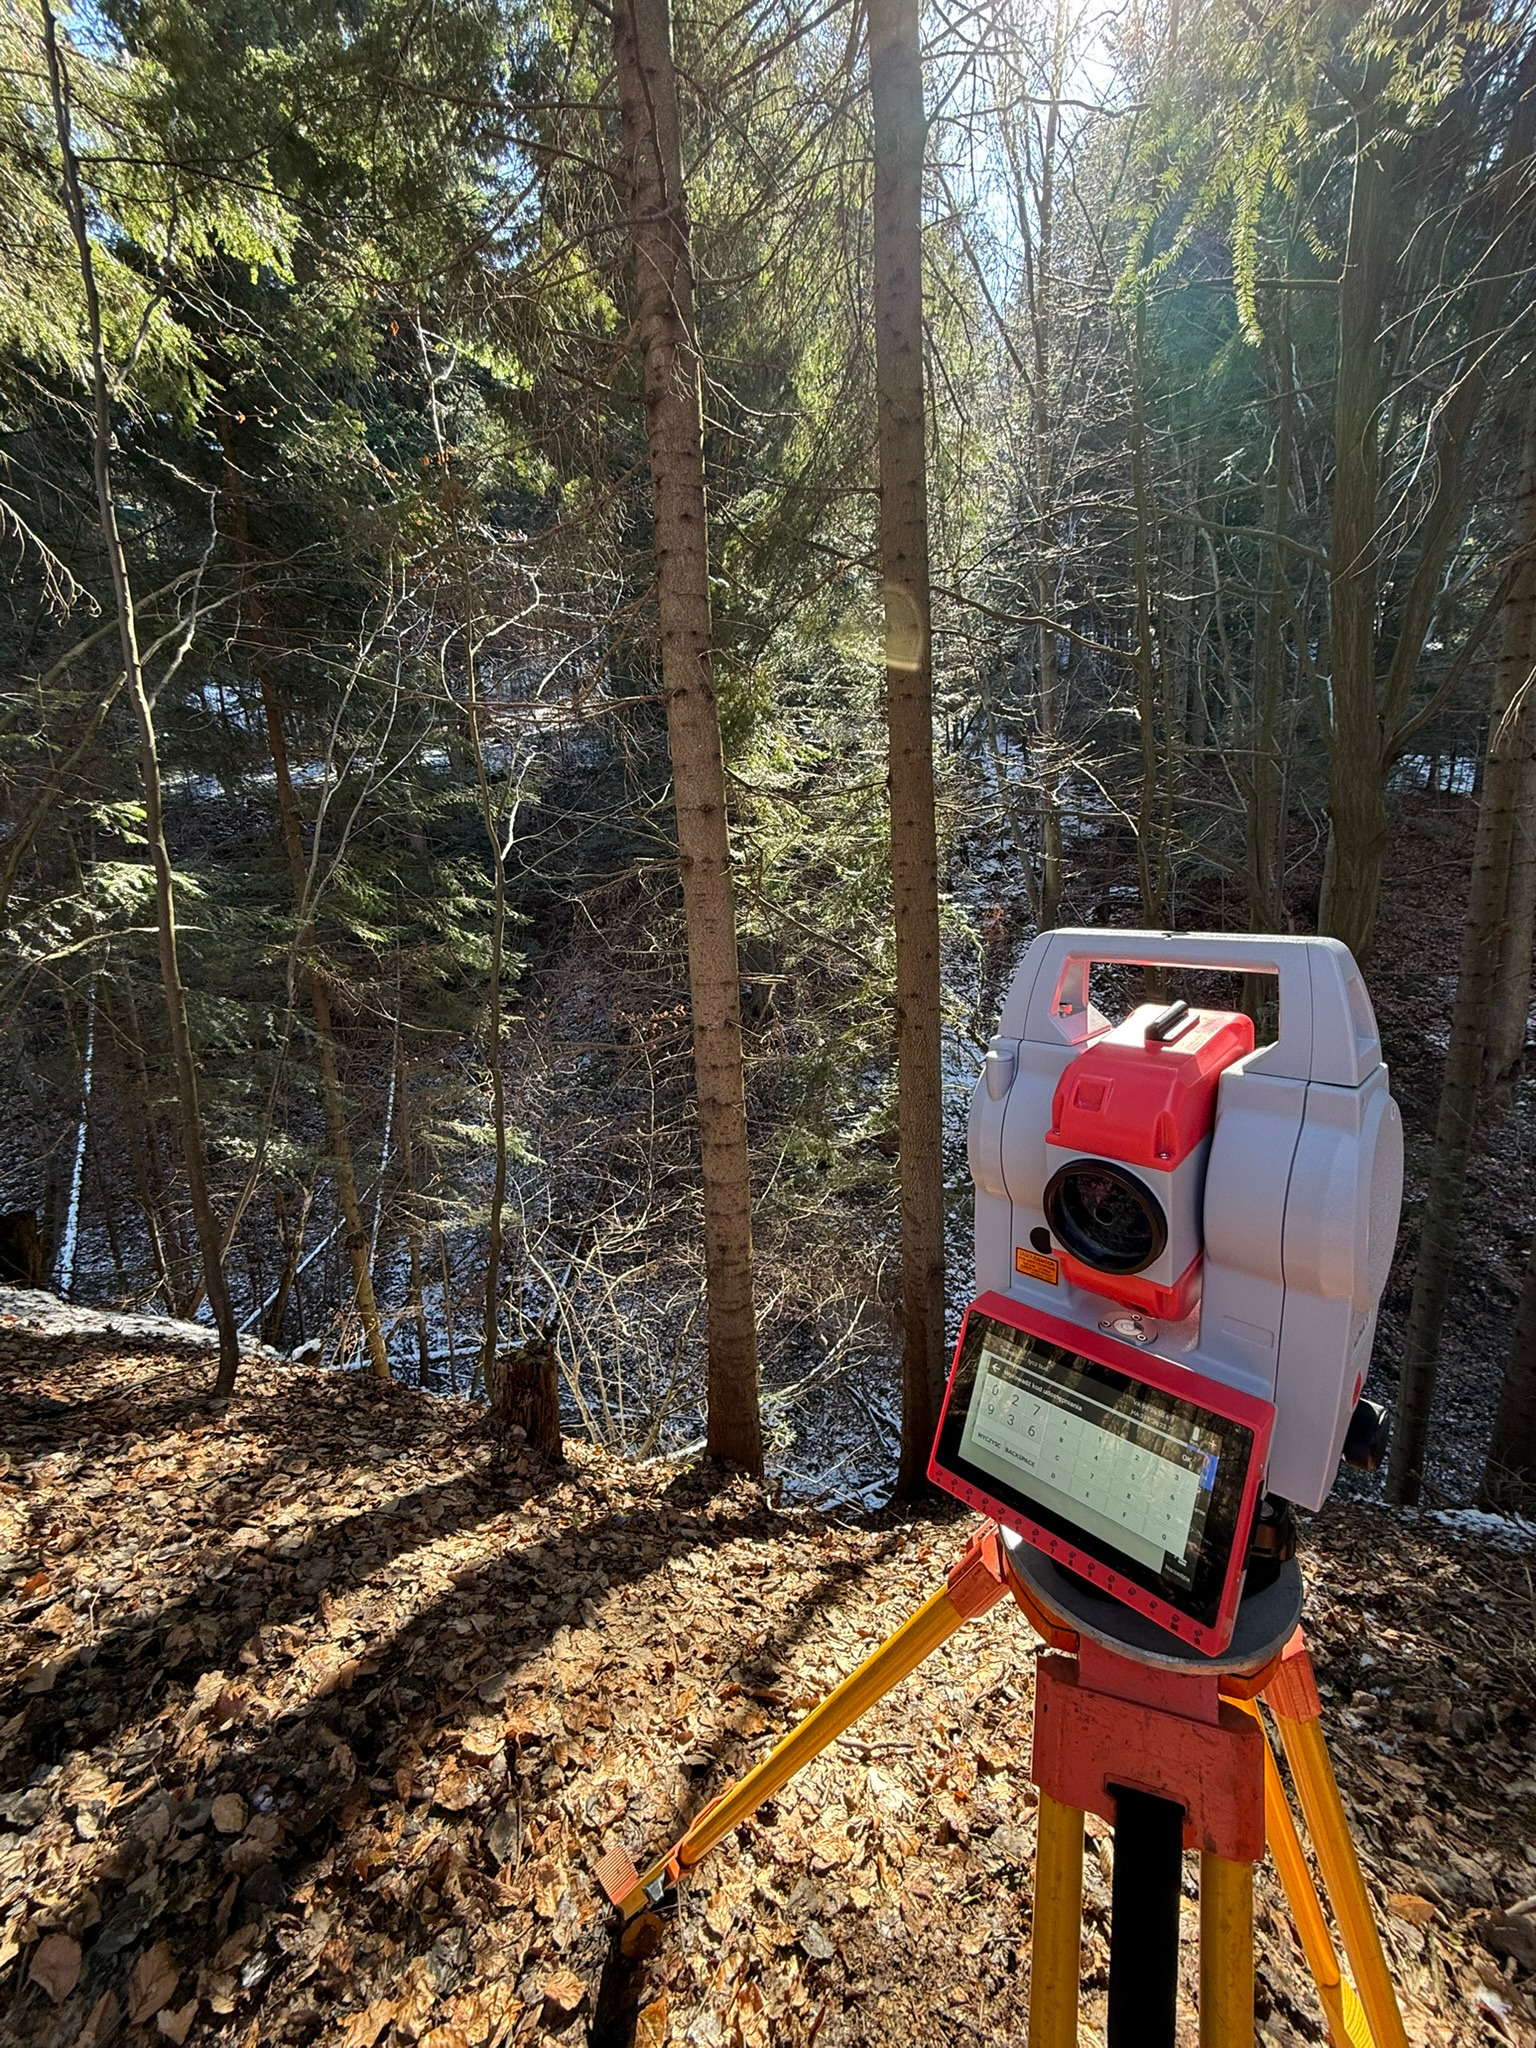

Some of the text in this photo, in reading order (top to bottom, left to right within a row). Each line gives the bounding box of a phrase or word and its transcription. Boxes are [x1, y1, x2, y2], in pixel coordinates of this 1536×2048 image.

[1031, 1381, 1043, 1392] kod
[991, 1384, 1041, 1416] 0 2 7
[987, 1404, 1036, 1437] 9 3 6
[1004, 1447, 1035, 1467] BACKSPACE
[1161, 1533, 1167, 1541] 0
